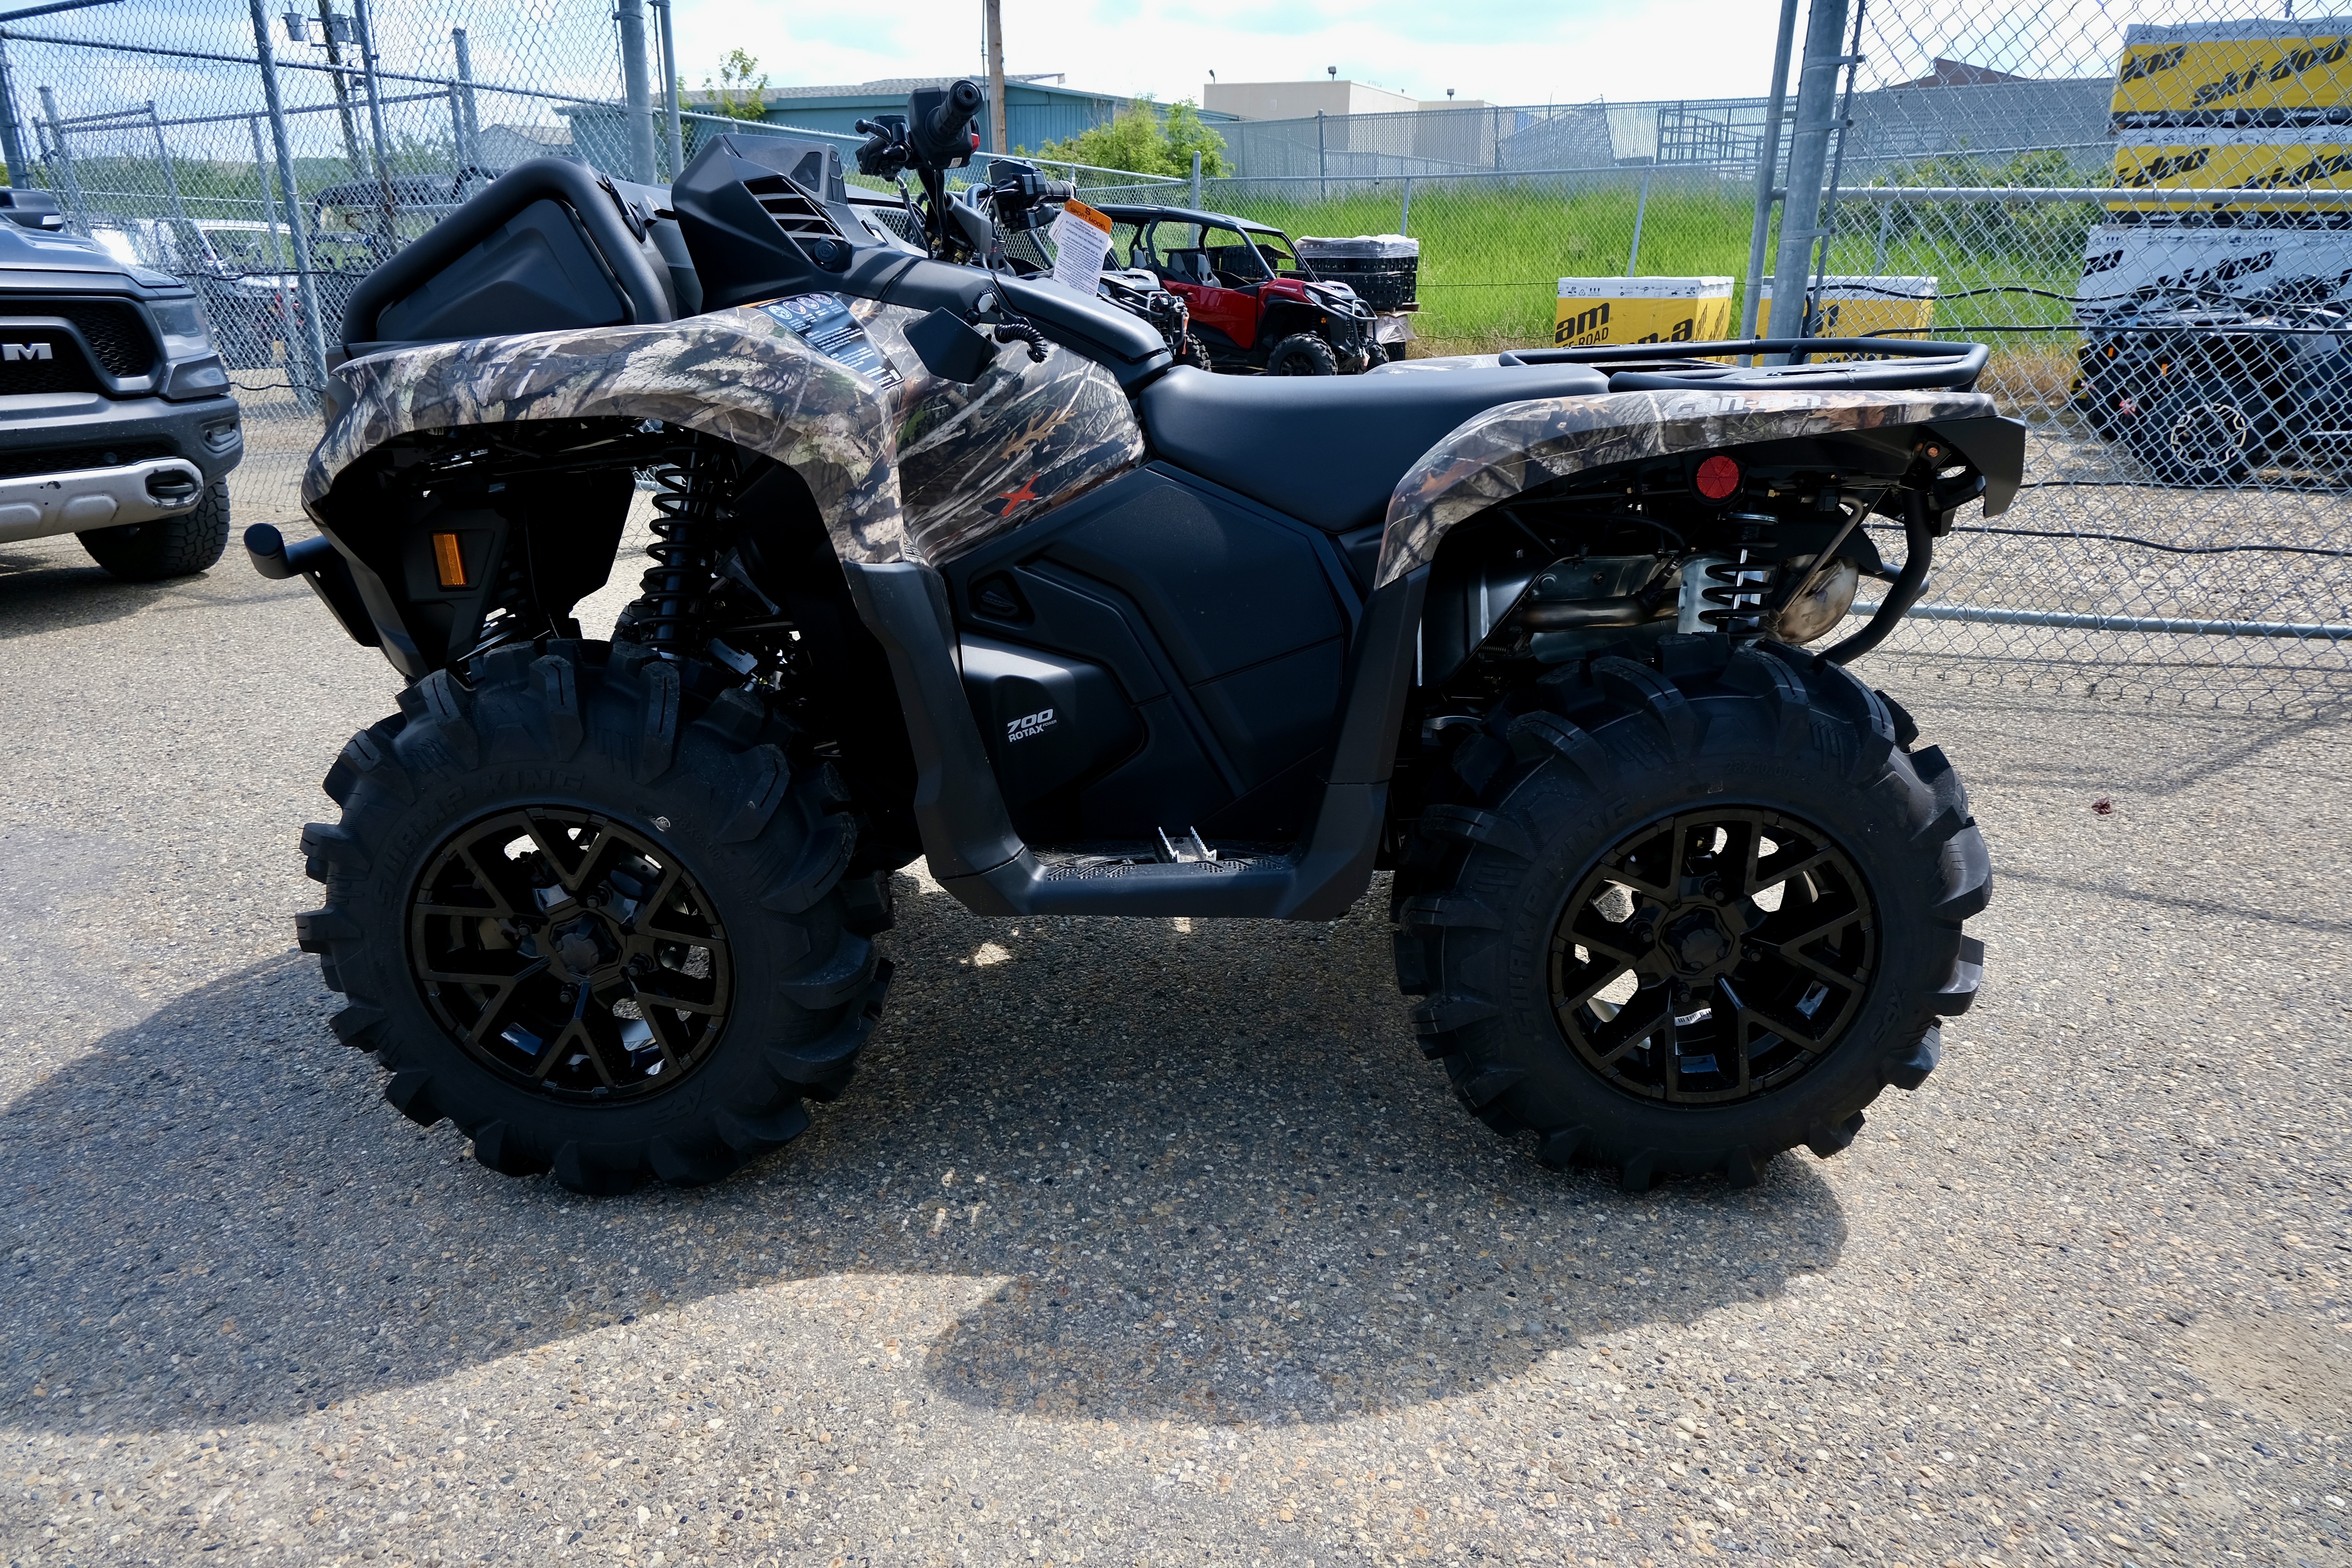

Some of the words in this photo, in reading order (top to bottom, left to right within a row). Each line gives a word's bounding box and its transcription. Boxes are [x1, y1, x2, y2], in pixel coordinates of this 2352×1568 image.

[2190, 38, 2350, 107] ski-doo
[1070, 207, 1088, 219] SPORT
[1088, 217, 1107, 231] MODEL
[1555, 302, 1610, 344] am
[443, 352, 631, 385] OUTLANDER
[1668, 395, 1822, 416] can-am
[1007, 708, 1054, 734] 700
[1008, 724, 1044, 742] ROTAX
[374, 786, 464, 909] SWAMP
[481, 769, 586, 798] KING
[1508, 884, 1542, 1036] SWAMP
[1546, 797, 1631, 880] KING
[1869, 981, 1909, 1049] XPS
